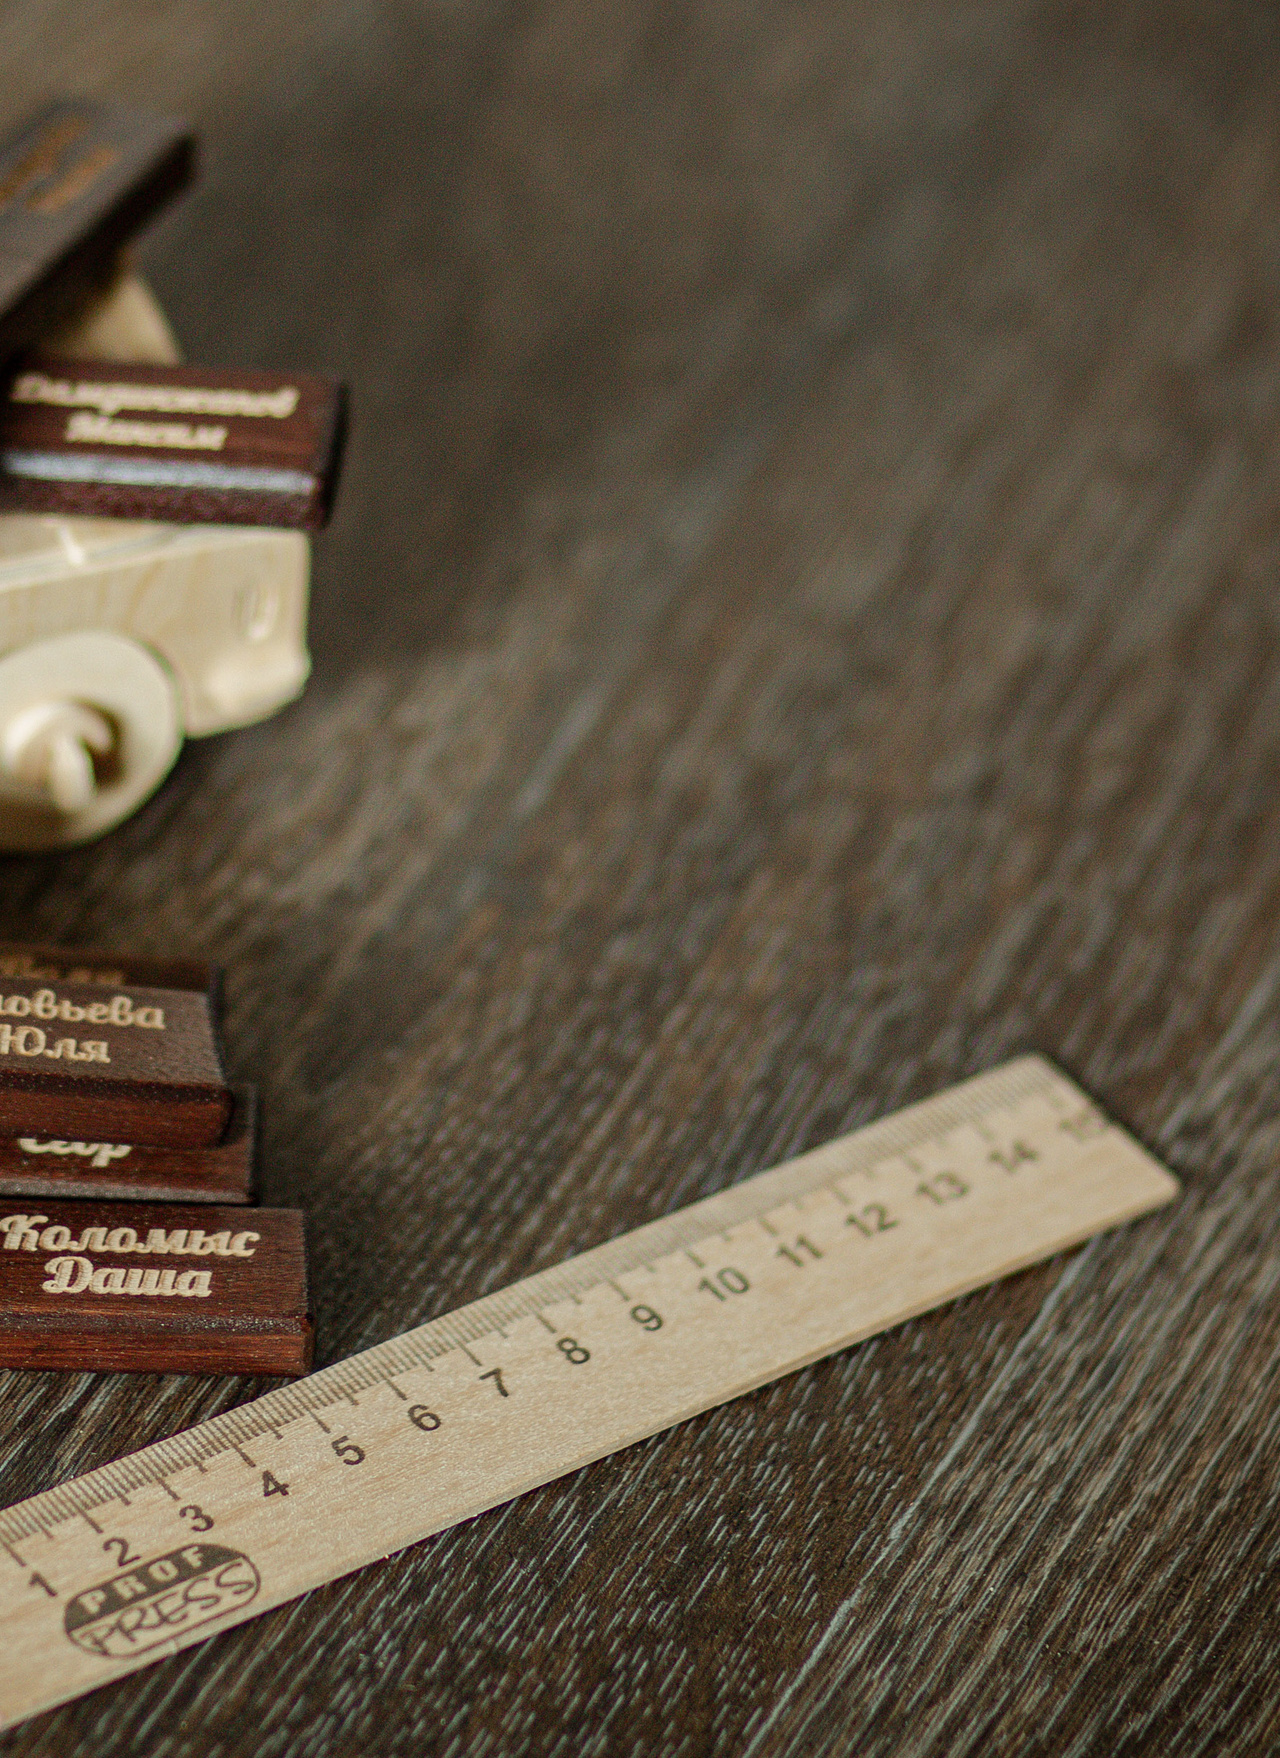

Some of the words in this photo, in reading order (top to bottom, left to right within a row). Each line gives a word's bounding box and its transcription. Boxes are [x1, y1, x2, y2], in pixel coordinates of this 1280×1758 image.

[41, 1255, 213, 1298] Даша
[29, 1572, 58, 1598] 1
[102, 1536, 142, 1567] 2
[179, 1504, 215, 1532] 3
[261, 1470, 290, 1498] 4
[331, 1435, 366, 1466] 5
[407, 1403, 442, 1432] 6
[479, 1367, 510, 1398] 7
[556, 1336, 592, 1366] 8
[629, 1303, 665, 1333] 9
[697, 1267, 752, 1302] 10
[776, 1234, 825, 1269] 11
[844, 1203, 900, 1239] 12
[915, 1171, 971, 1206] 13
[987, 1140, 1039, 1174] 14
[78, 1546, 204, 1614] PROF
[79, 1562, 255, 1657] PRESS
